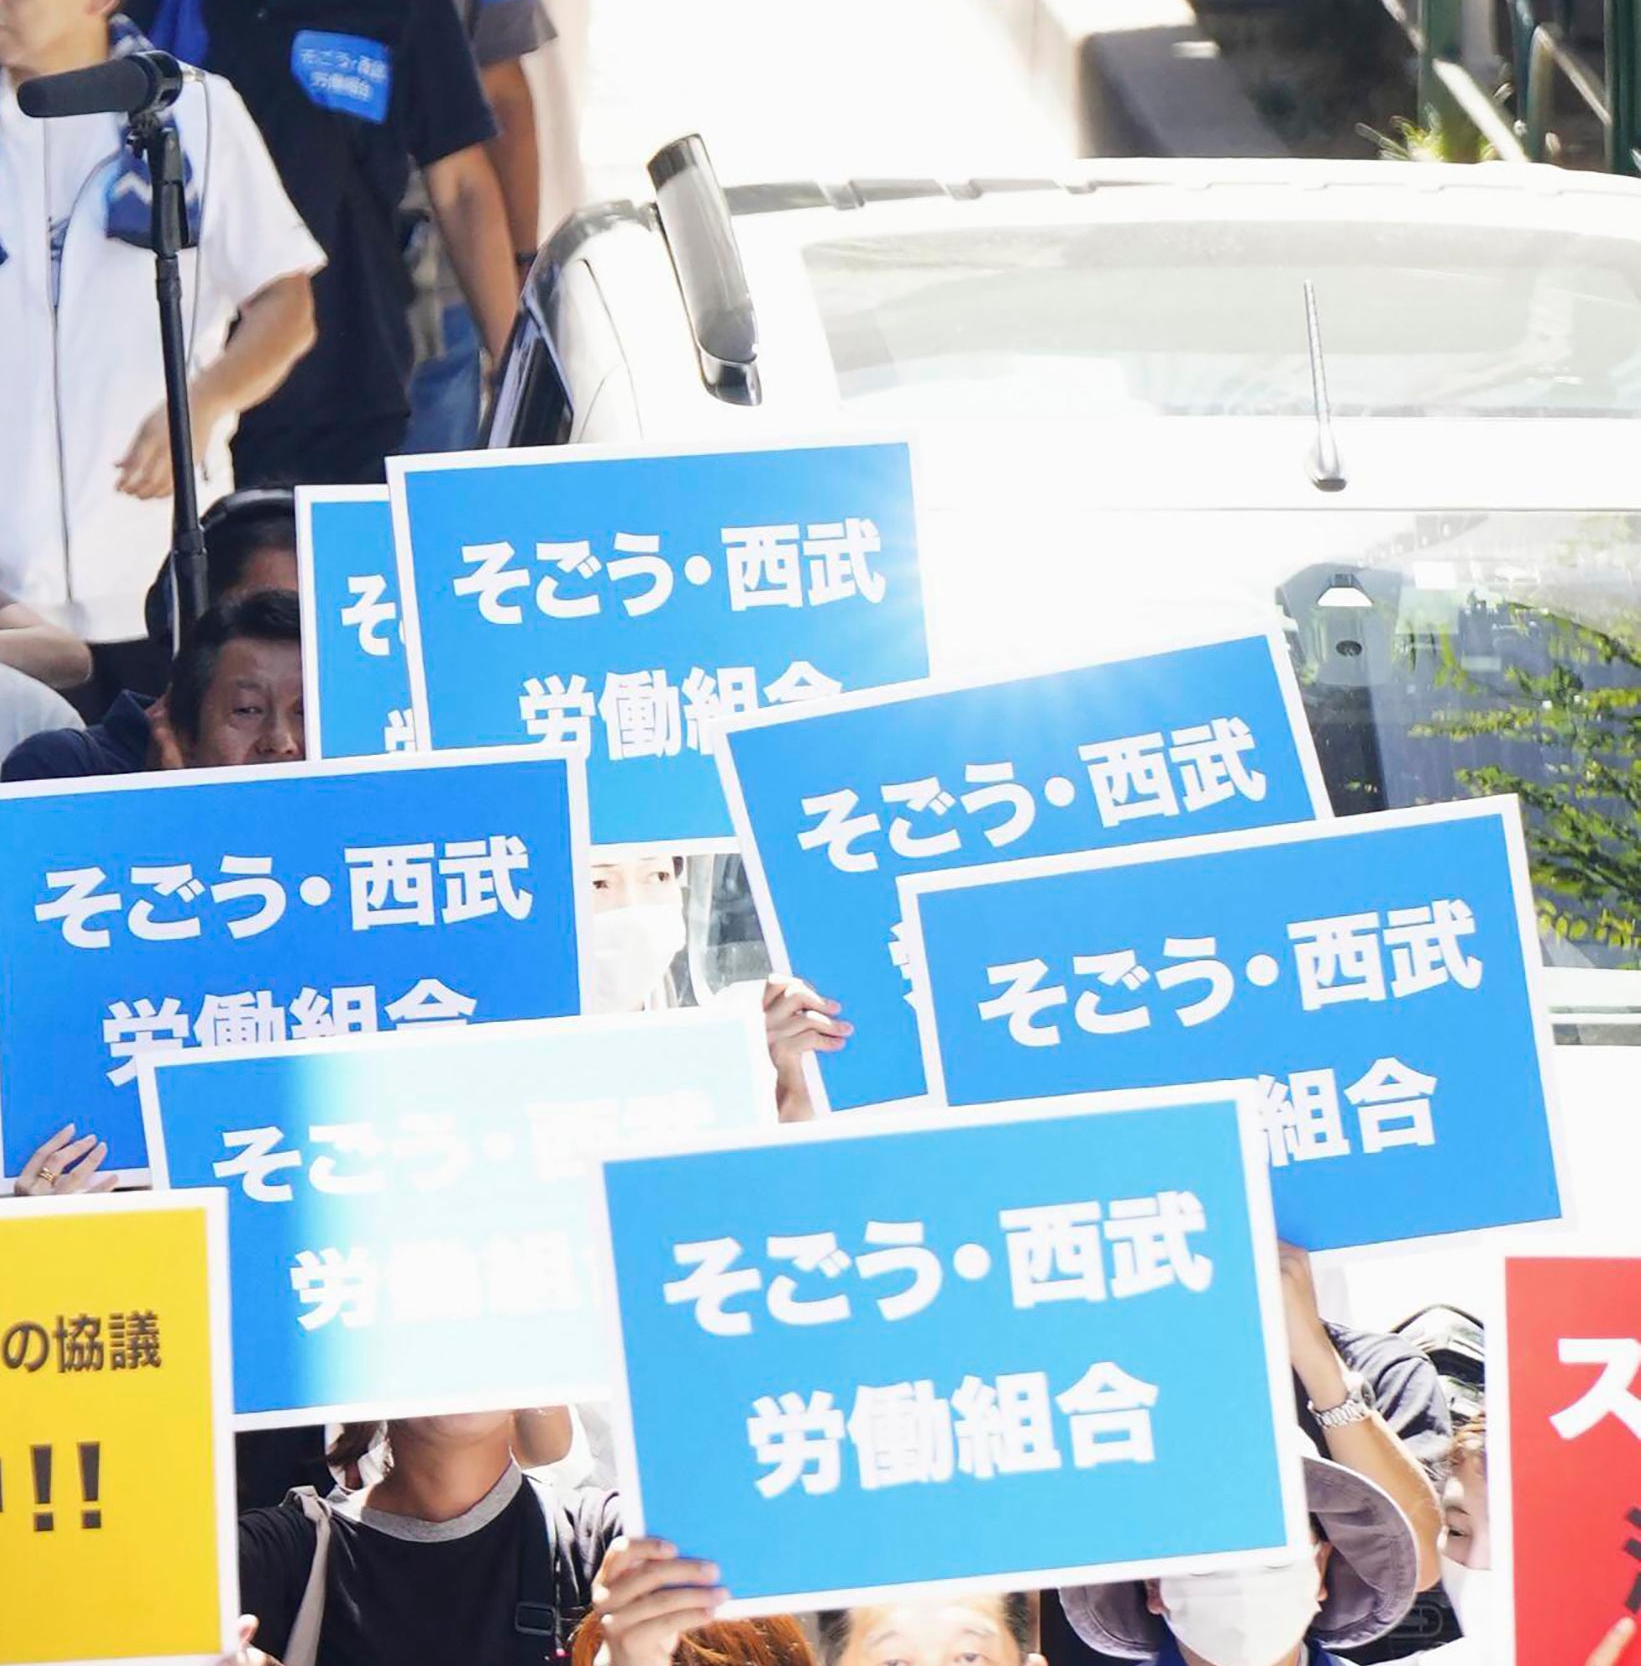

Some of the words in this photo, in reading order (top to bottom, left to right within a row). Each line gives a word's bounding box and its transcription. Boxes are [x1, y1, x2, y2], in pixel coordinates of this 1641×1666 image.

[453, 517, 887, 625] そごう・西武
[797, 717, 1267, 873] そごう・西武
[34, 835, 534, 949] そごう・西武
[977, 899, 1483, 1046] そごう・西武
[664, 1190, 1214, 1336] そごう・西武
[748, 1362, 1161, 1501] 労働組合
